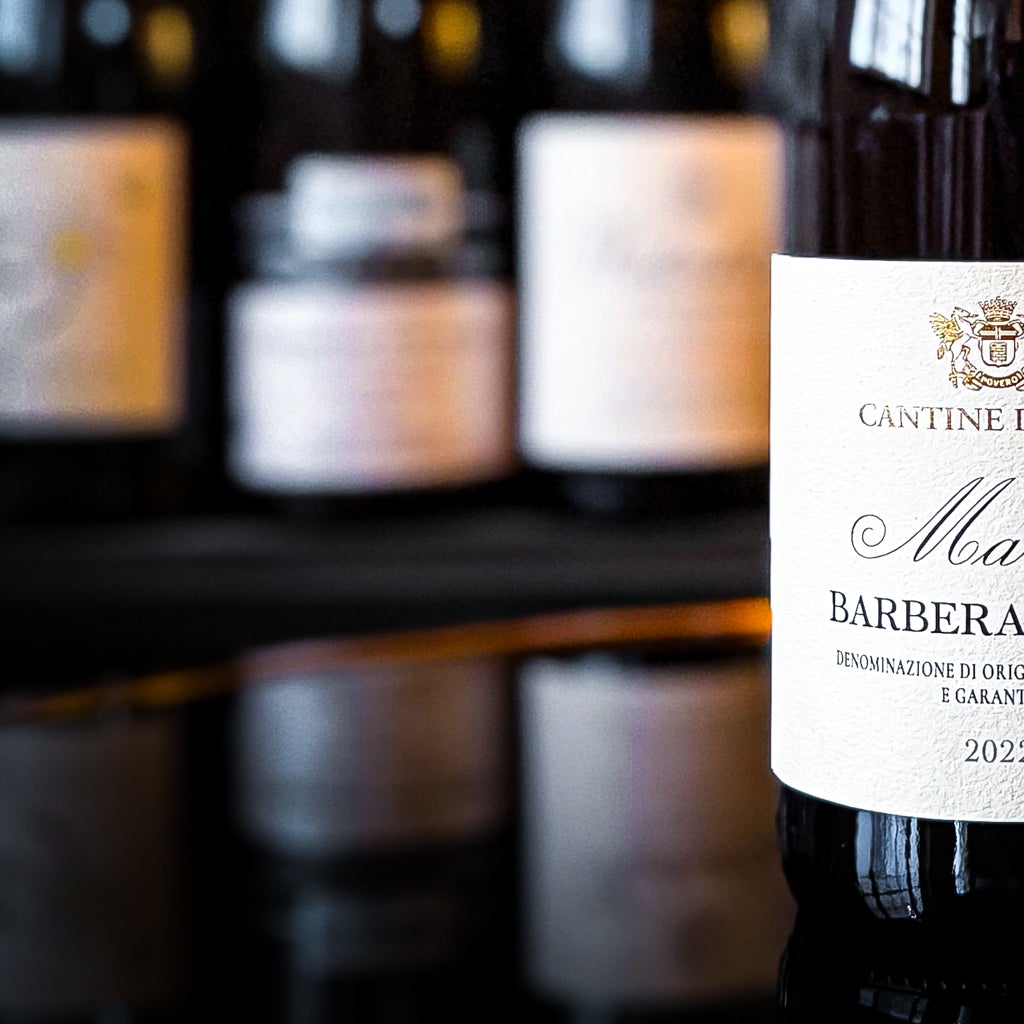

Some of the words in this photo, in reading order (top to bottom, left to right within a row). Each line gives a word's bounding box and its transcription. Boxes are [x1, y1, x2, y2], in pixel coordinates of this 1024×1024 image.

[859, 403, 1004, 432] CANTINE
[836, 649, 955, 679] DENOMINAZIONE
[960, 662, 977, 680] DI
[941, 687, 950, 704] E
